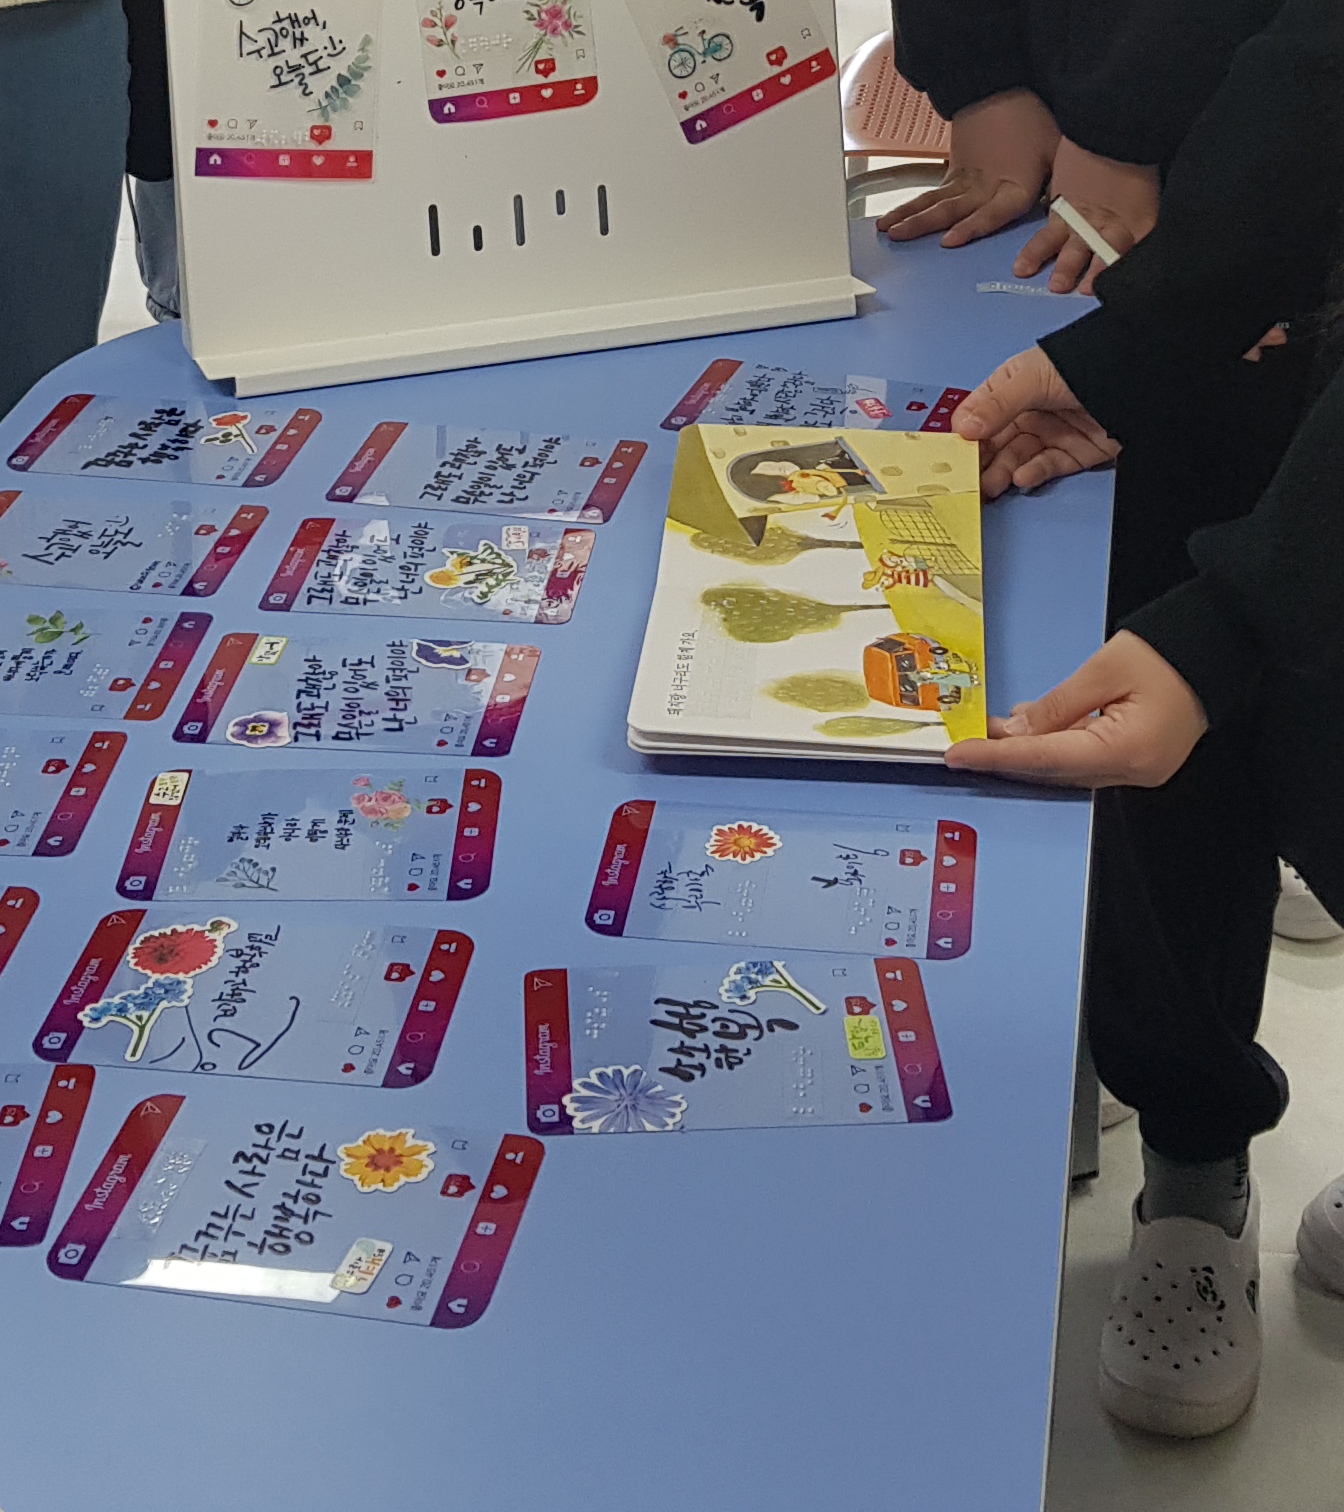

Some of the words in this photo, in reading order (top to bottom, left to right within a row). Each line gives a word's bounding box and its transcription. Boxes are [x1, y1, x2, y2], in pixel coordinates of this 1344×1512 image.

[269, 49, 332, 96] 오늘도
[419, 471, 463, 500] 그래도
[497, 491, 529, 504] 난
[511, 471, 540, 489] 너의
[88, 527, 143, 560] 오늘도
[307, 571, 342, 605] 그래도
[399, 562, 426, 584] 너의
[342, 655, 380, 694] 있어도
[384, 640, 419, 683] 편이야
[383, 686, 412, 711] 너의
[294, 700, 329, 743] 그래도
[382, 713, 417, 733] 난
[602, 843, 631, 887] Instagram
[63, 958, 104, 1006] Instagram
[534, 1022, 558, 1076] Instagram
[224, 1119, 304, 1199] 사람은
[83, 1153, 133, 1211] Instagram
[245, 1142, 337, 1256] 행복하다
